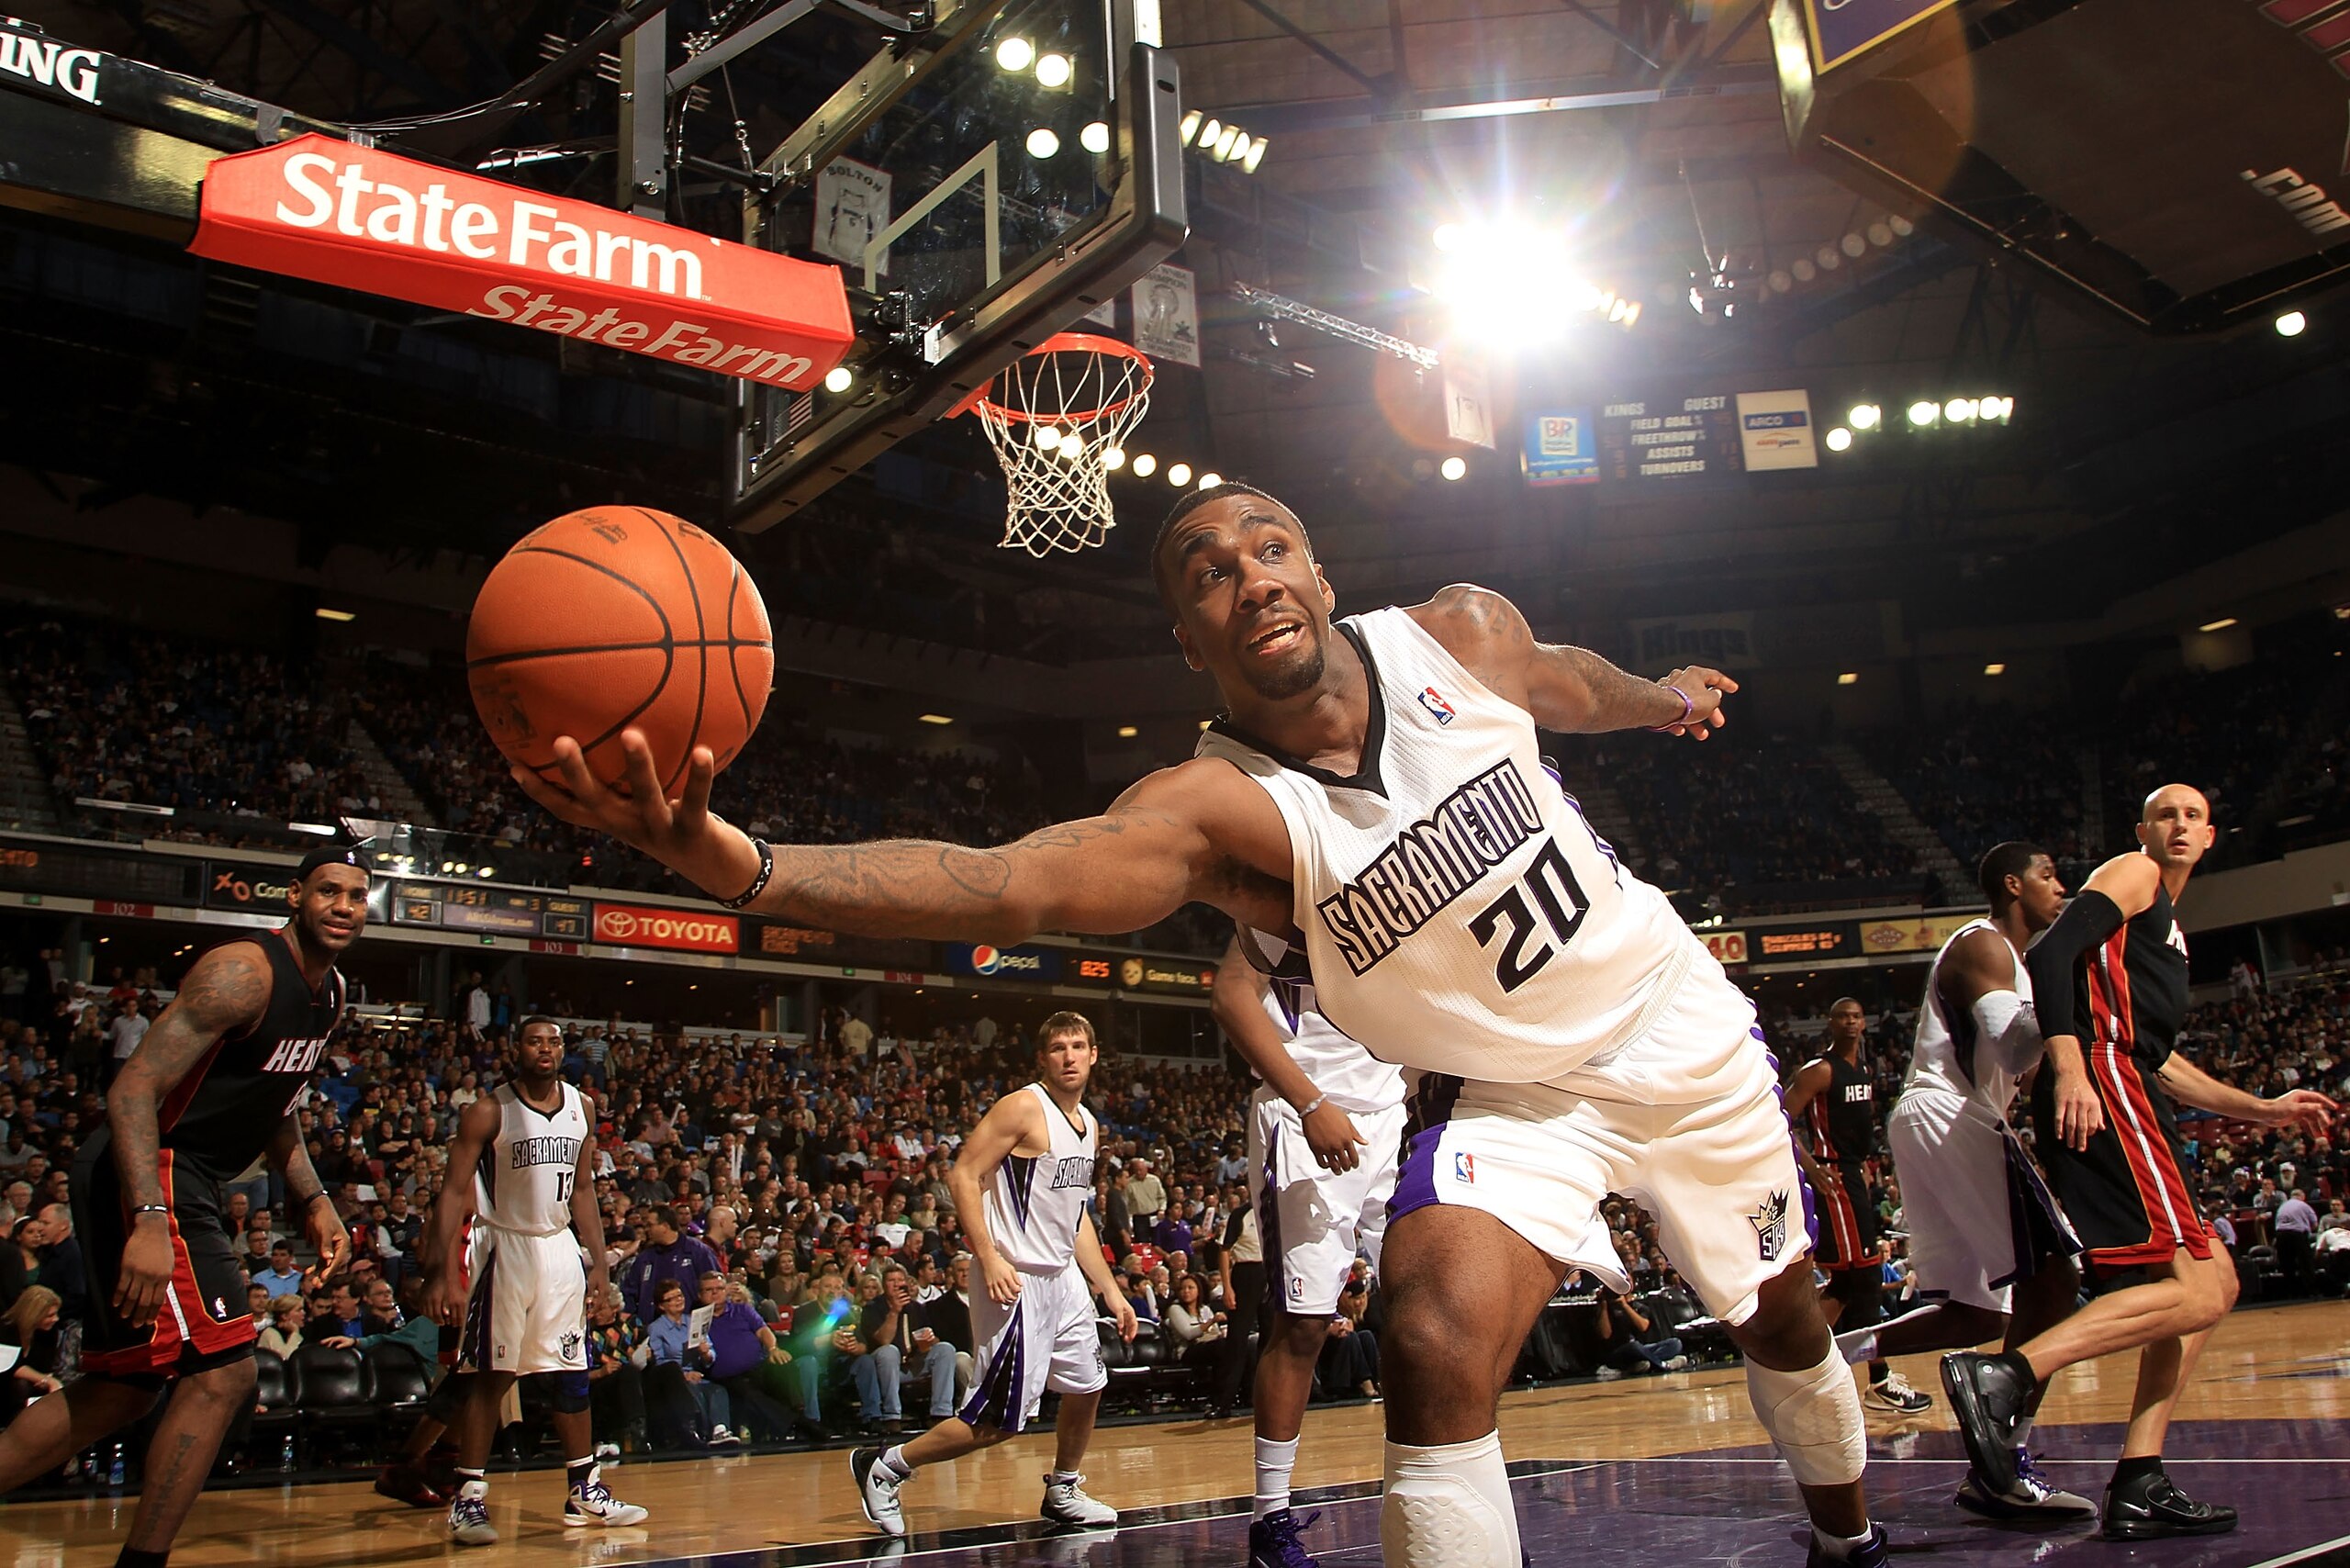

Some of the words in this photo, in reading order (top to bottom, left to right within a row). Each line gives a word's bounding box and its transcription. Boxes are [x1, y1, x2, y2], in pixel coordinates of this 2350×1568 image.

[275, 152, 498, 259] State
[509, 200, 702, 299] Farm
[464, 285, 649, 348] State
[641, 319, 812, 384] Farm
[1604, 402, 1646, 418] KINGS
[1684, 396, 1727, 411] GUEST
[1630, 418, 1662, 430] FIELD
[1748, 416, 1784, 428] ARCO
[1646, 445, 1695, 460] ASSISTS
[1639, 460, 1706, 476] TURNOVERS
[1316, 757, 1545, 978] SACRAMENTO
[112, 902, 136, 916] 102
[548, 902, 581, 913] GUEST
[1469, 836, 1591, 995] 20
[639, 917, 733, 945] TOYOTA
[543, 940, 564, 954] 103
[997, 953, 1040, 971] pepsi
[1146, 969, 1175, 983] Game
